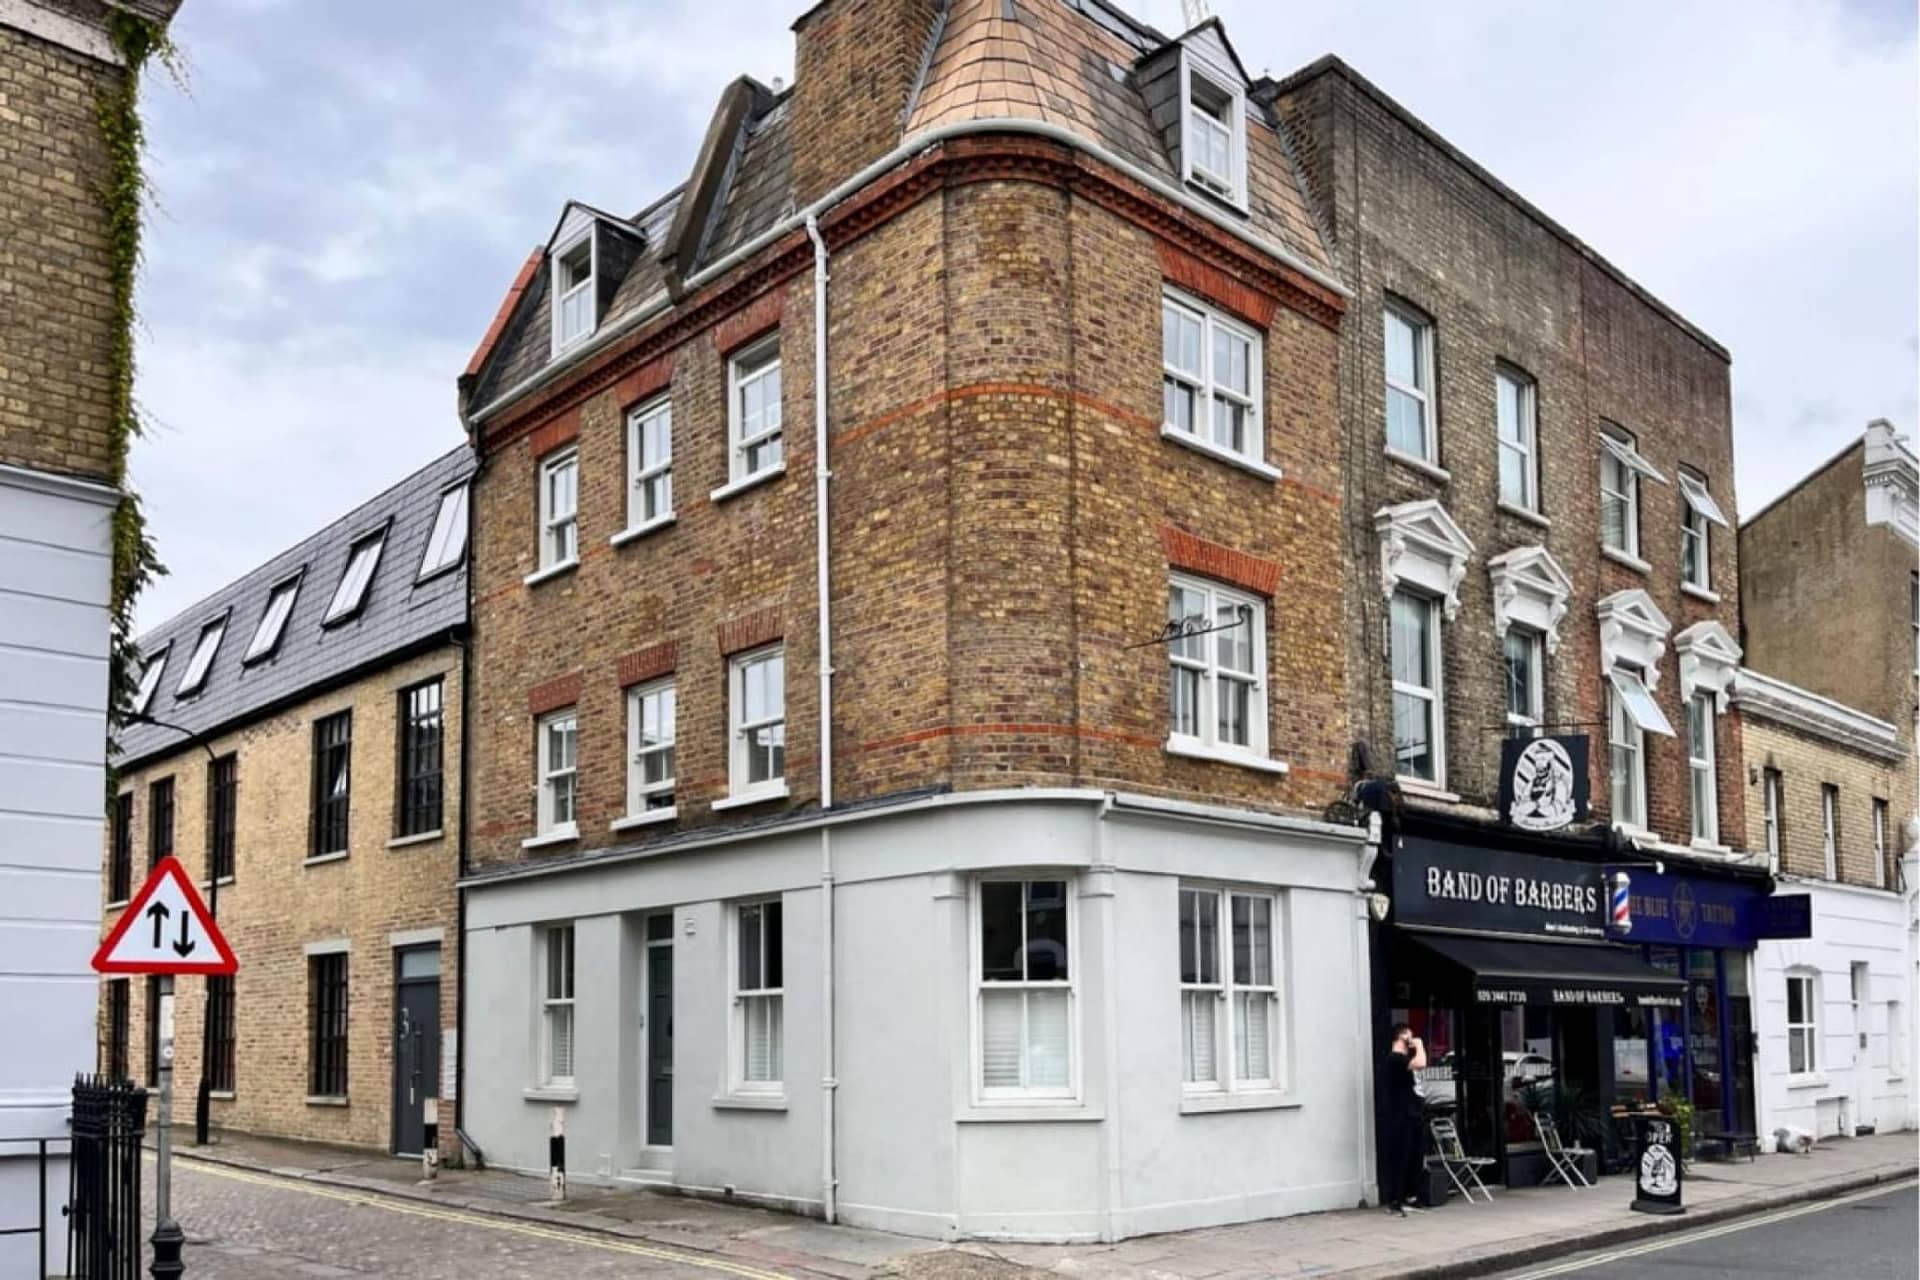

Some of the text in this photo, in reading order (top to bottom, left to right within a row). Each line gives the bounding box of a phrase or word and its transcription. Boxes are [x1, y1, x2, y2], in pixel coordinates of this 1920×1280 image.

[1427, 866, 1597, 914] BAND OF BARBERS
